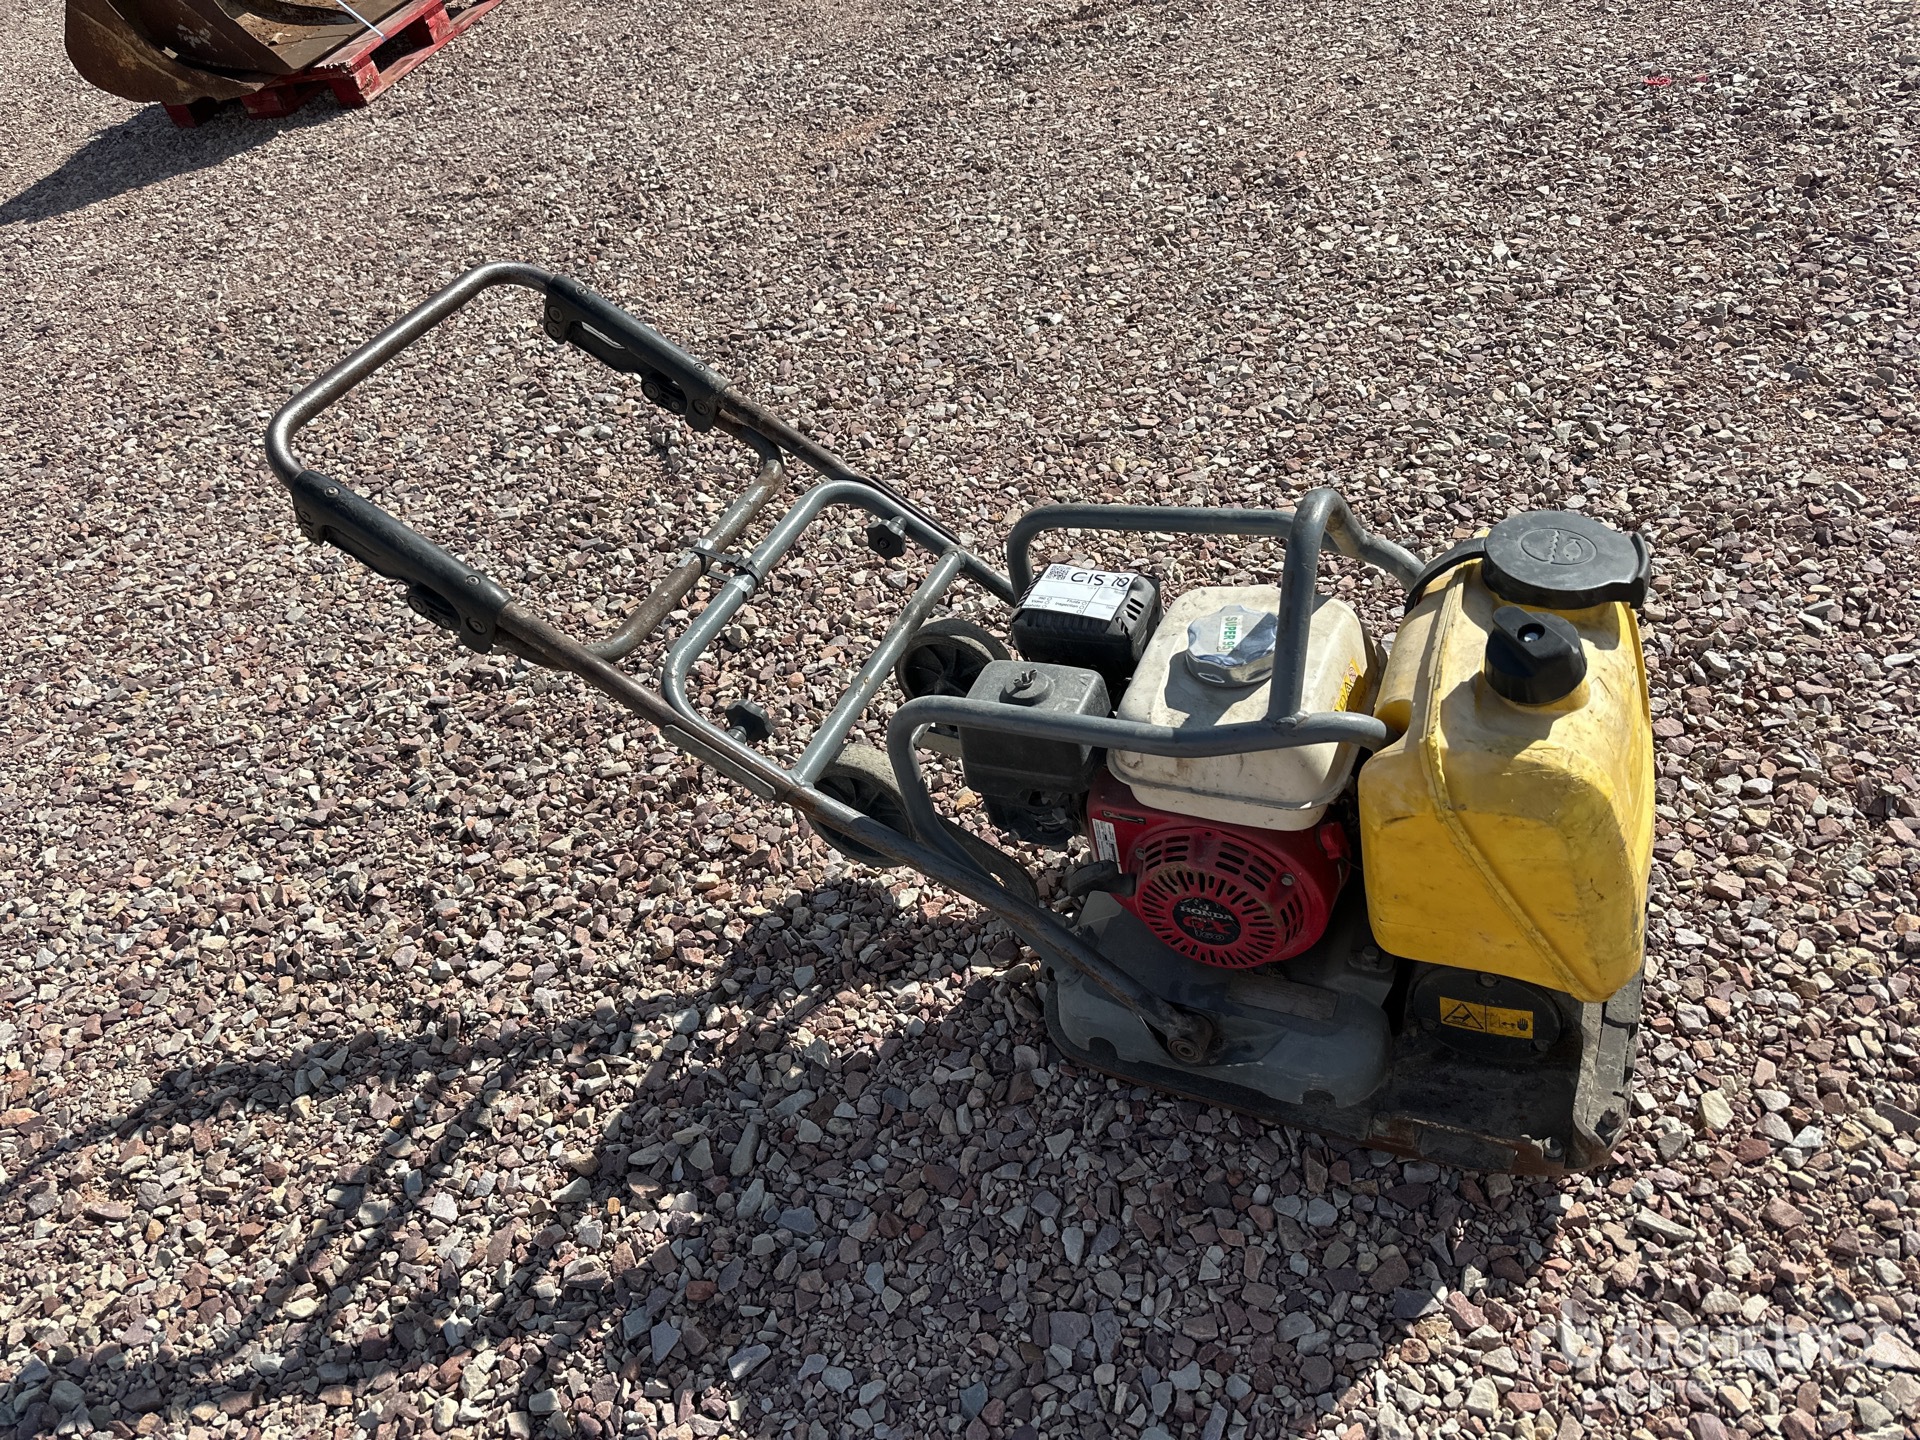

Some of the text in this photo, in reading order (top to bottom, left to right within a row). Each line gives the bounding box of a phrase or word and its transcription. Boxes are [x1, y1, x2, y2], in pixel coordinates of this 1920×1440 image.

[1223, 616, 1238, 640] SUPER
[1180, 905, 1235, 922] HONDA
[1183, 916, 1232, 934] GX
